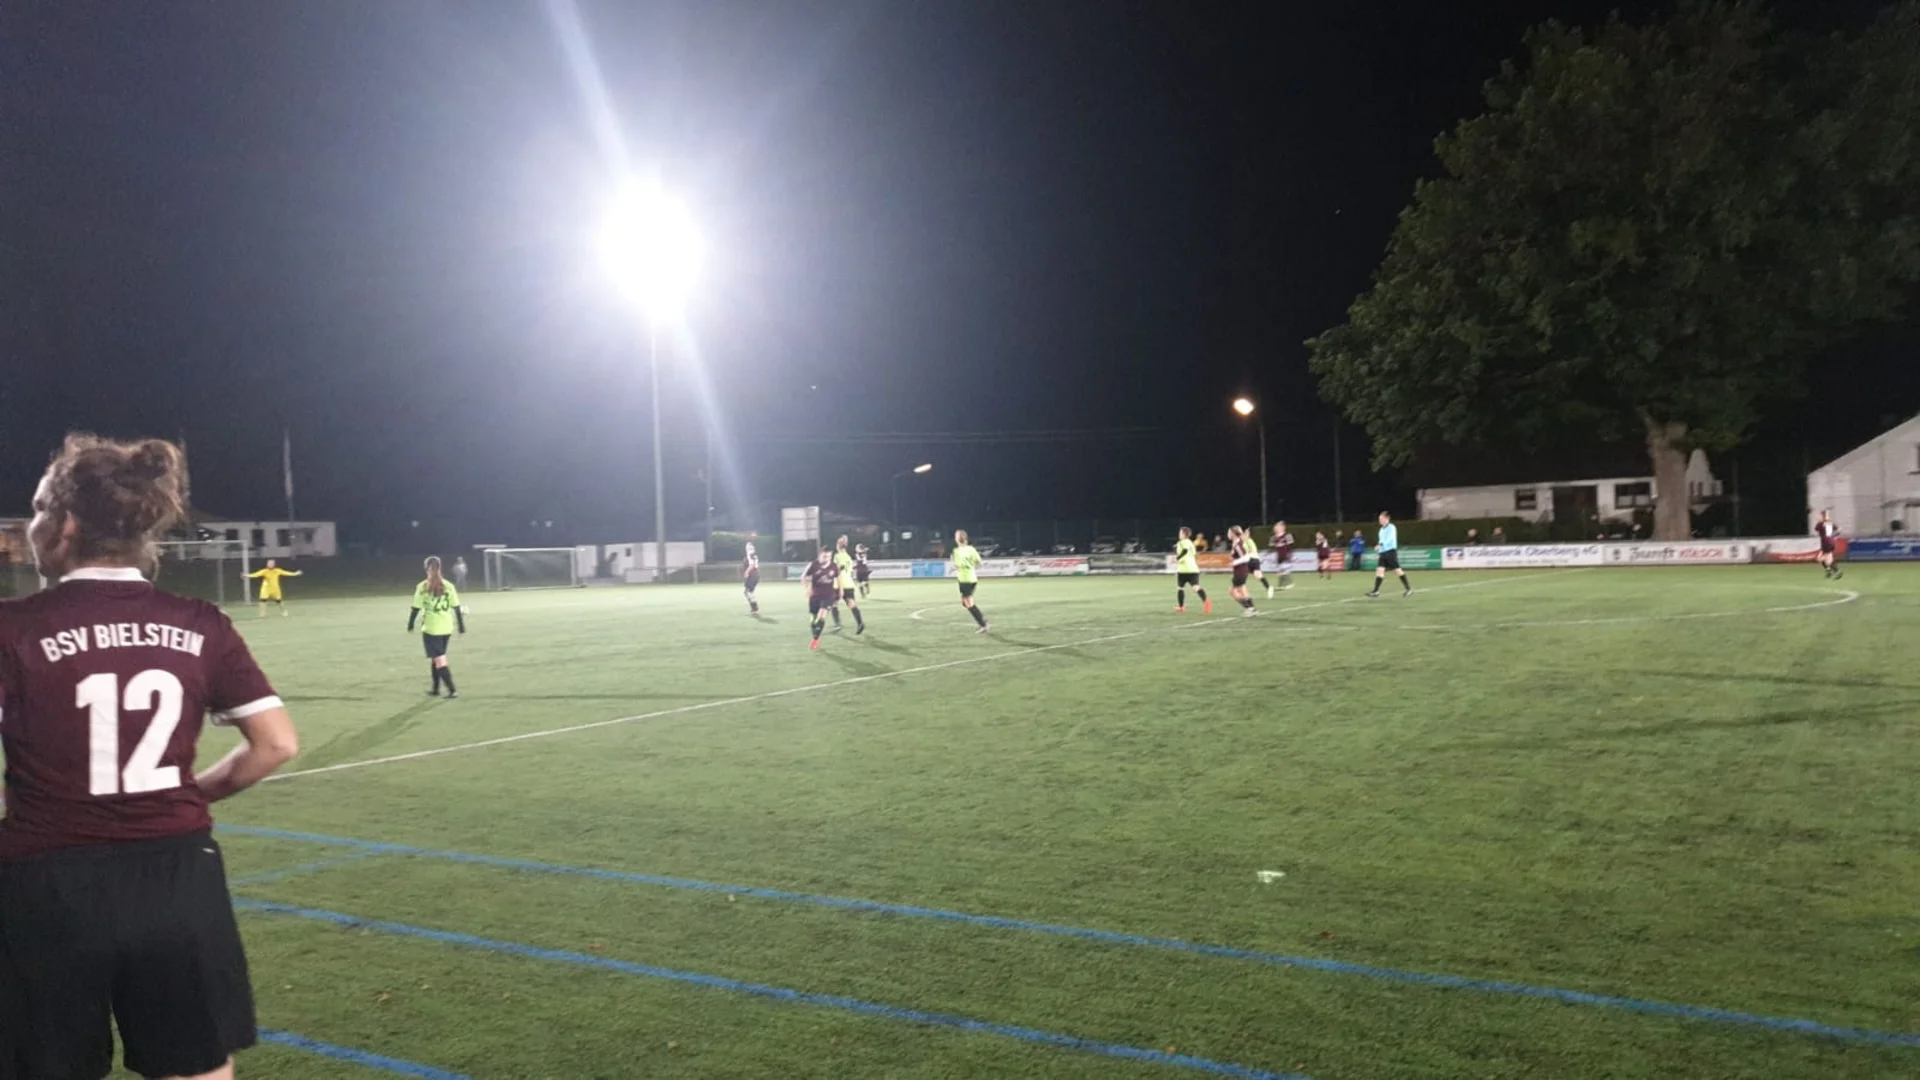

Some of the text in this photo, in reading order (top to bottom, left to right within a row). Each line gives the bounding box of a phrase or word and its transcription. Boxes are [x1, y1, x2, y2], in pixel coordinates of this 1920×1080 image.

[39, 622, 205, 663] BSV BIELSTEIN
[74, 668, 184, 796] 12
